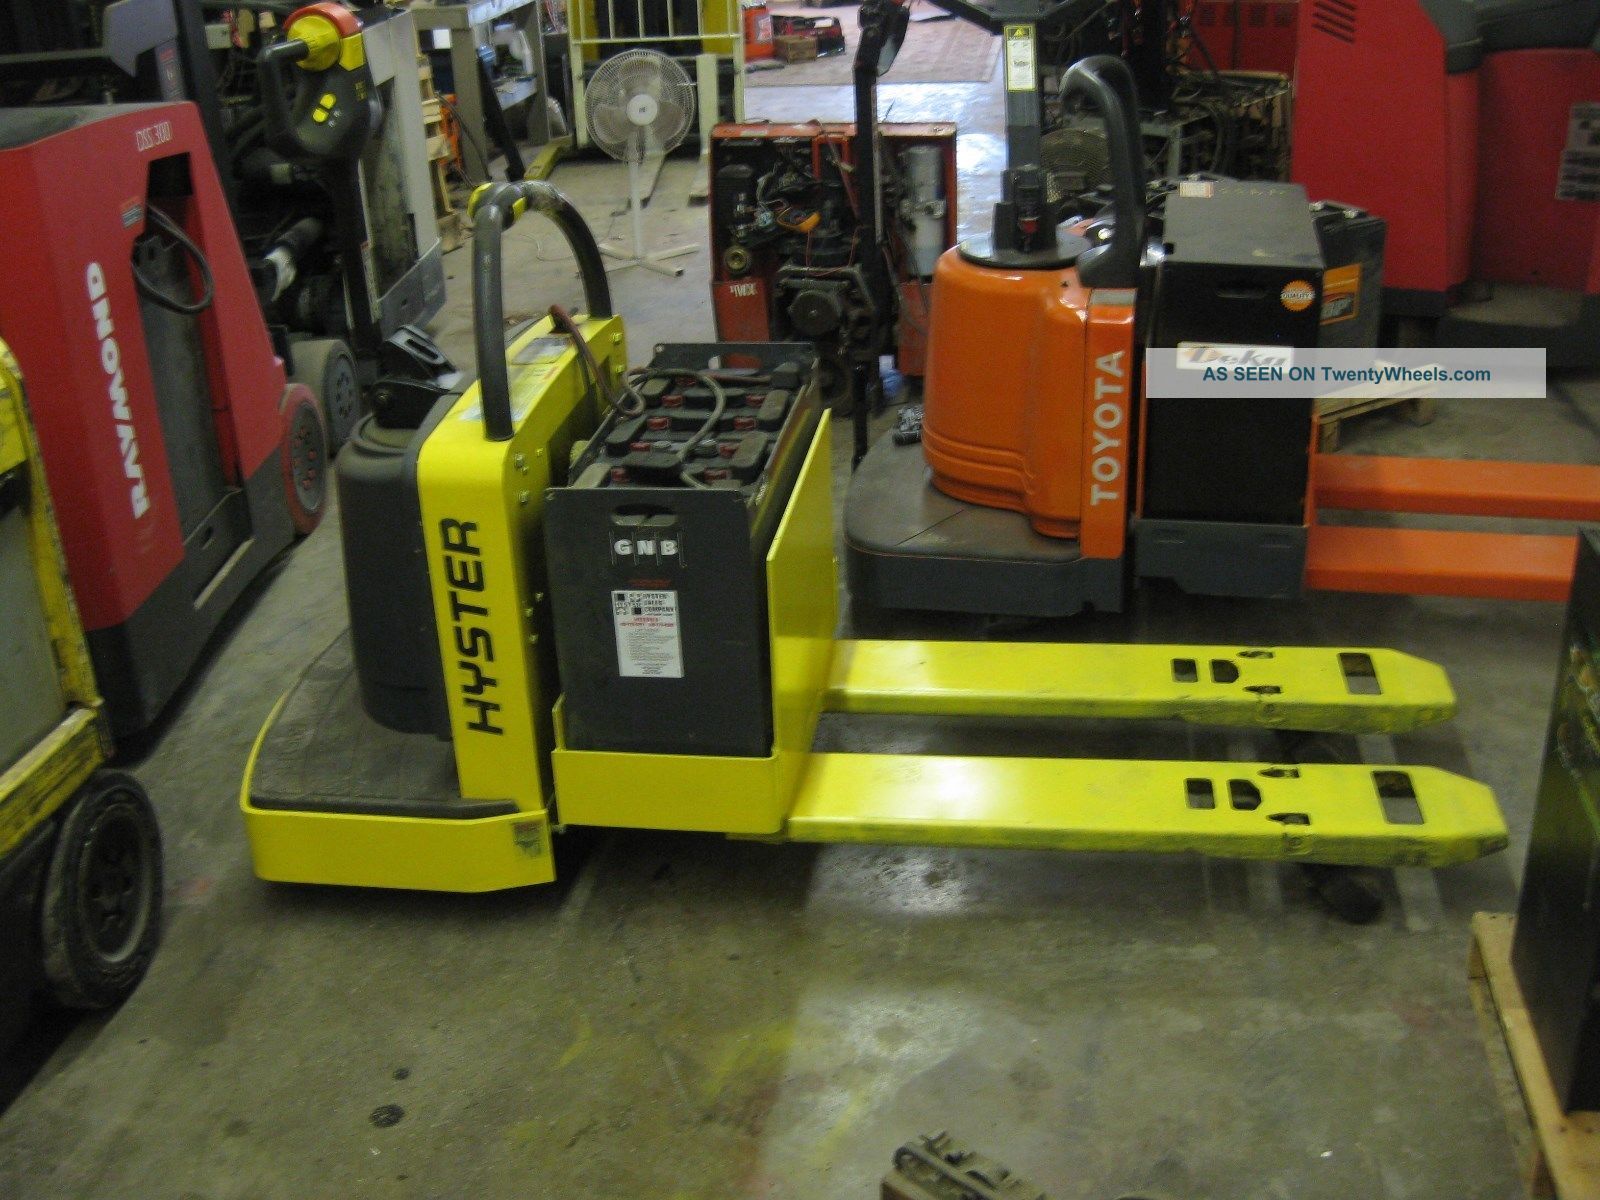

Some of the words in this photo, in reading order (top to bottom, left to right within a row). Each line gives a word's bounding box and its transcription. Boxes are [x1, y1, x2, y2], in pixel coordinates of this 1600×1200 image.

[86, 261, 151, 520] RAYMOND
[1090, 350, 1126, 507] TOYOTA
[440, 517, 504, 736] HYSTER
[613, 539, 679, 555] GNB
